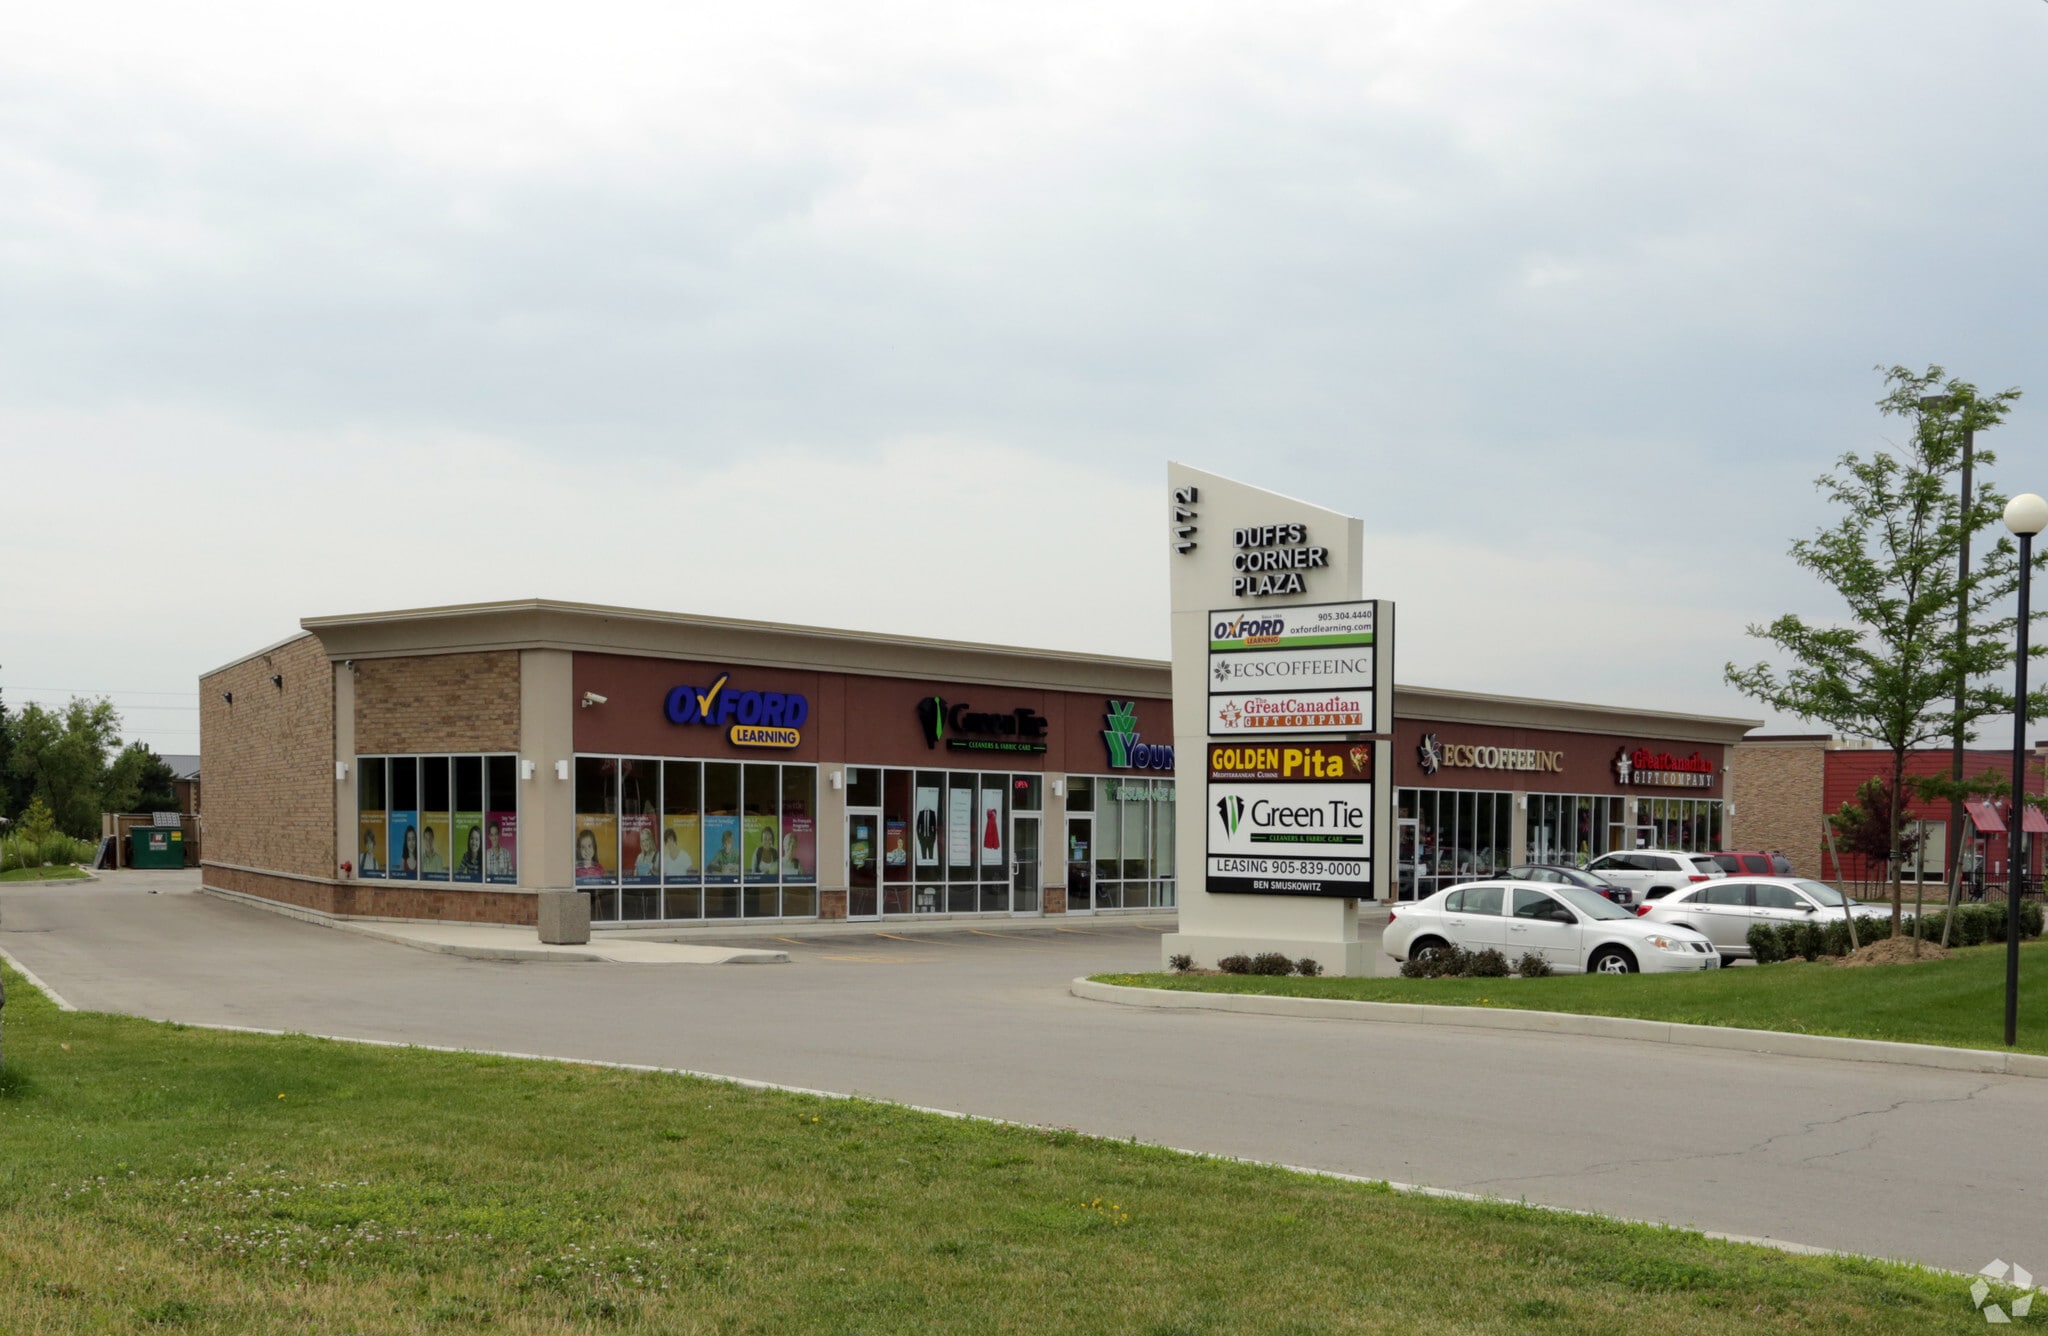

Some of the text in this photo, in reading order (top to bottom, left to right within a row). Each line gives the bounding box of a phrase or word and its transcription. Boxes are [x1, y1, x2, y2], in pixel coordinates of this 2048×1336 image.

[1173, 486, 1198, 554] 1172
[1233, 523, 1307, 550] DUFFS
[1232, 547, 1329, 573] CORNER
[1232, 573, 1307, 598] PLAZA
[1318, 610, 1372, 622] 905.304.4440
[1214, 615, 1285, 639] OXFORD
[1290, 623, 1372, 635] oxfordlearning.com
[1247, 636, 1278, 644] LEARNING
[1233, 658, 1368, 678] ECSCOFFEEINC
[665, 674, 808, 728] OXFORD
[1244, 714, 1358, 727] GIFT COMPANY
[737, 729, 797, 744] LEARNING
[968, 741, 994, 749] CLEANERS
[1212, 748, 1344, 777] GOLDEN Pita
[1443, 743, 1563, 772] ECSCOFFEEINC
[1634, 770, 1711, 787] GIFT COMPANY
[1251, 799, 1363, 828] Green Tie
[1268, 834, 1298, 842] CLEANERS
[1216, 859, 1361, 876] LEASING 905-839-0000
[1253, 880, 1321, 891] BEN SMUSKOWITZ
